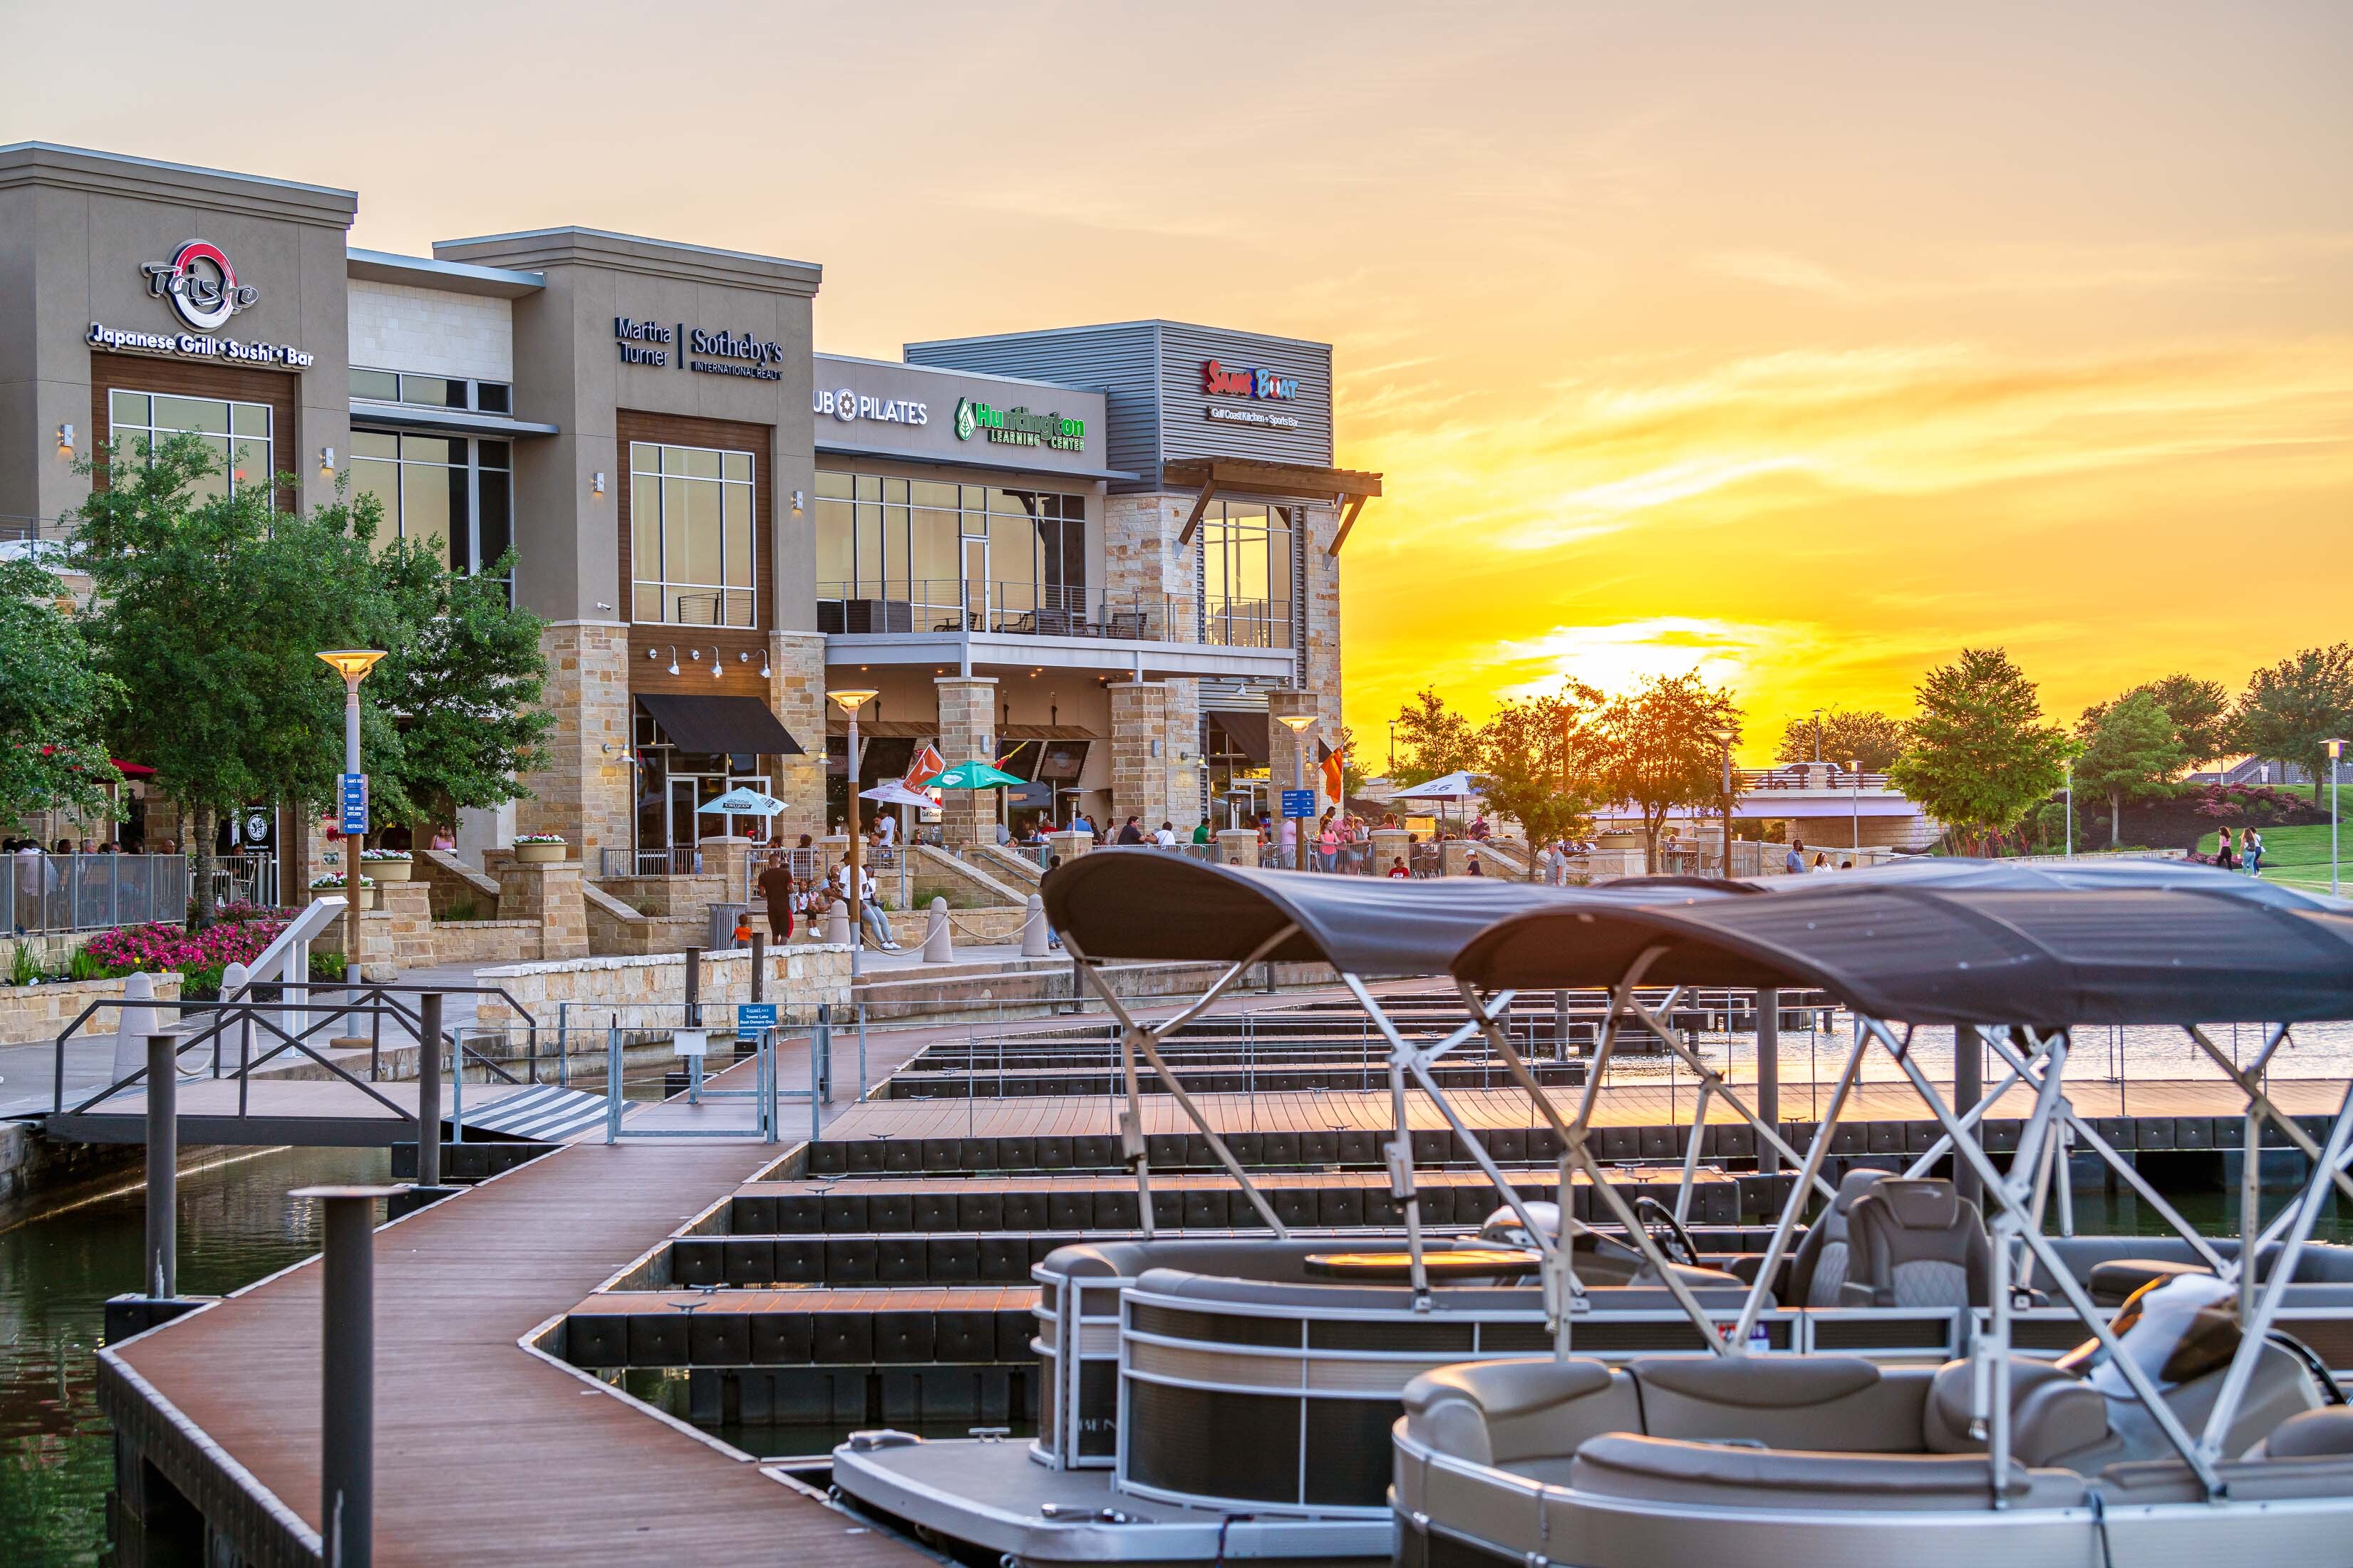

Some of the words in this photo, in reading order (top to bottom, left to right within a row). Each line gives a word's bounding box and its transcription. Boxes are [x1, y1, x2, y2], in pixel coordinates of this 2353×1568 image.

[145, 263, 259, 311] Taisho
[618, 317, 672, 343] Martha
[92, 323, 176, 351] Japanese
[178, 334, 217, 355] Grill
[228, 341, 273, 362] Sushi
[286, 347, 314, 366] Bar
[621, 341, 669, 366] Turner
[694, 328, 784, 367] Sotheby's
[695, 361, 755, 378] INTERNATIONAL
[757, 368, 783, 380] REALTY
[860, 396, 929, 425] PILATES
[976, 402, 1085, 440] Huntington
[1211, 408, 1225, 418] Gulf
[1225, 409, 1242, 421] Coast
[1242, 411, 1265, 422] Kitchen
[1268, 415, 1288, 427] Sports
[1288, 417, 1298, 427] Bar
[991, 430, 1041, 447] LEARNING
[1051, 436, 1085, 451] CENTER
